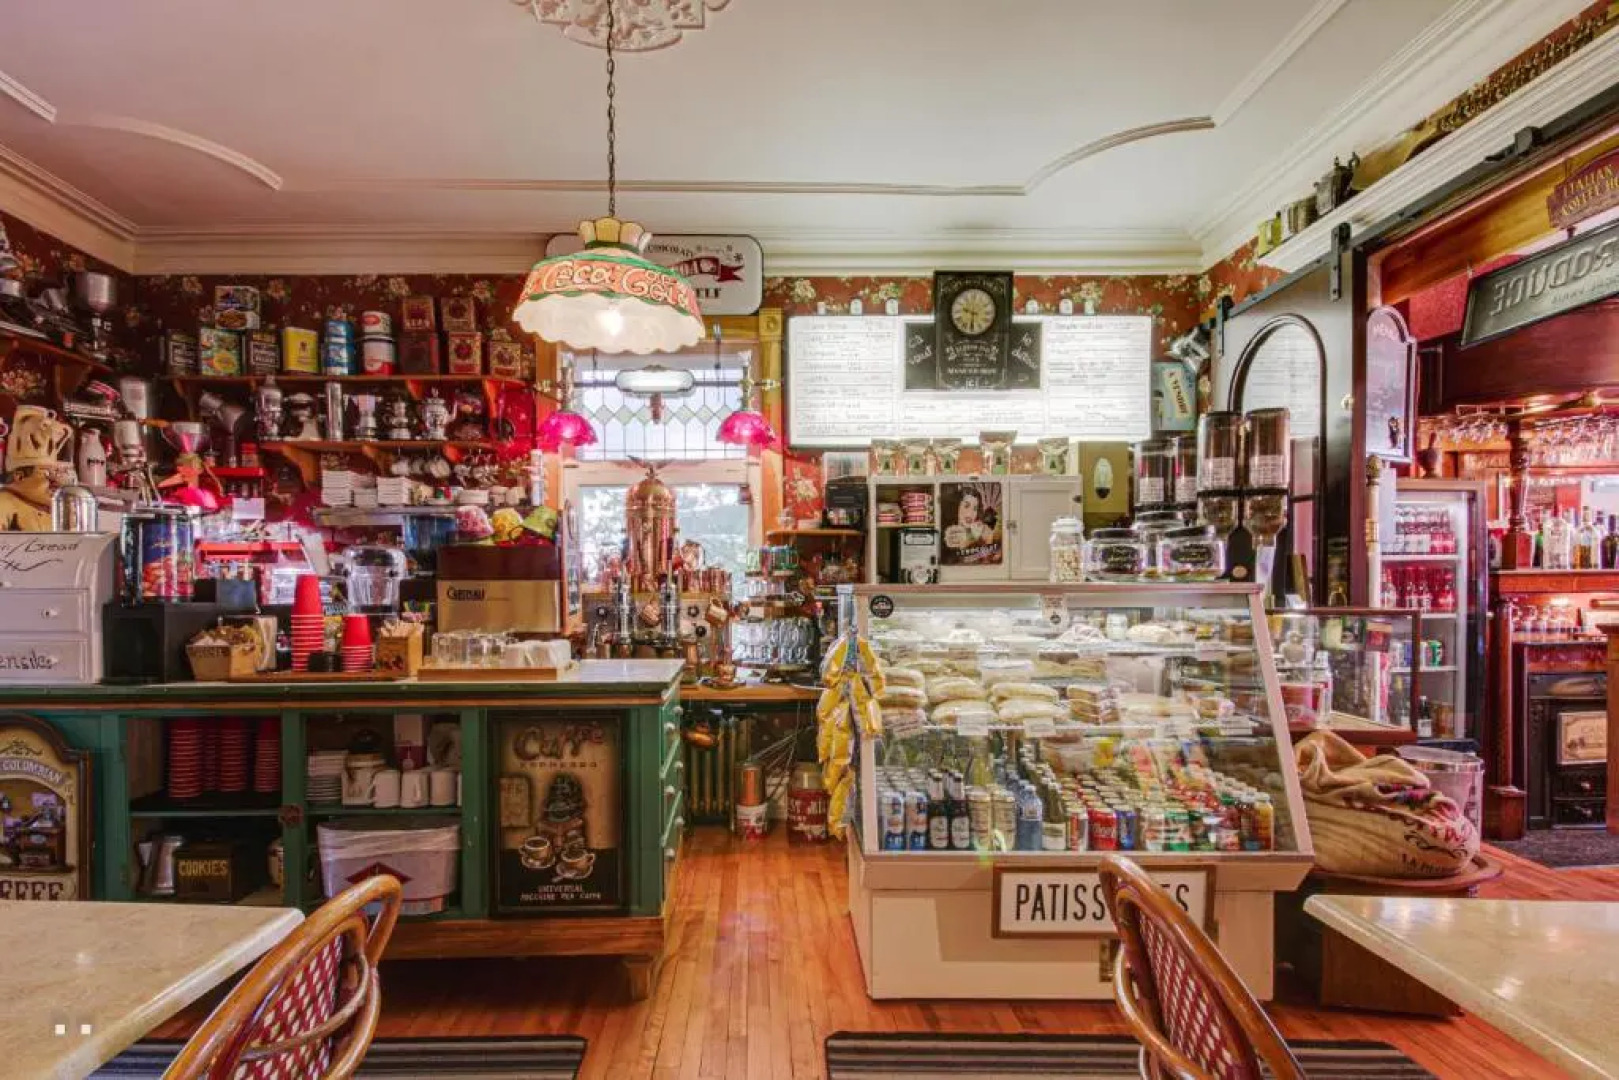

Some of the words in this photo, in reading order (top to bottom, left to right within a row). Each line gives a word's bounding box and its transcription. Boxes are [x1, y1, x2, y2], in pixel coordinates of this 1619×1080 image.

[1563, 163, 1612, 198] ITALIAN
[178, 860, 229, 877] COOKIES
[1015, 883, 1190, 921] PATISSS
